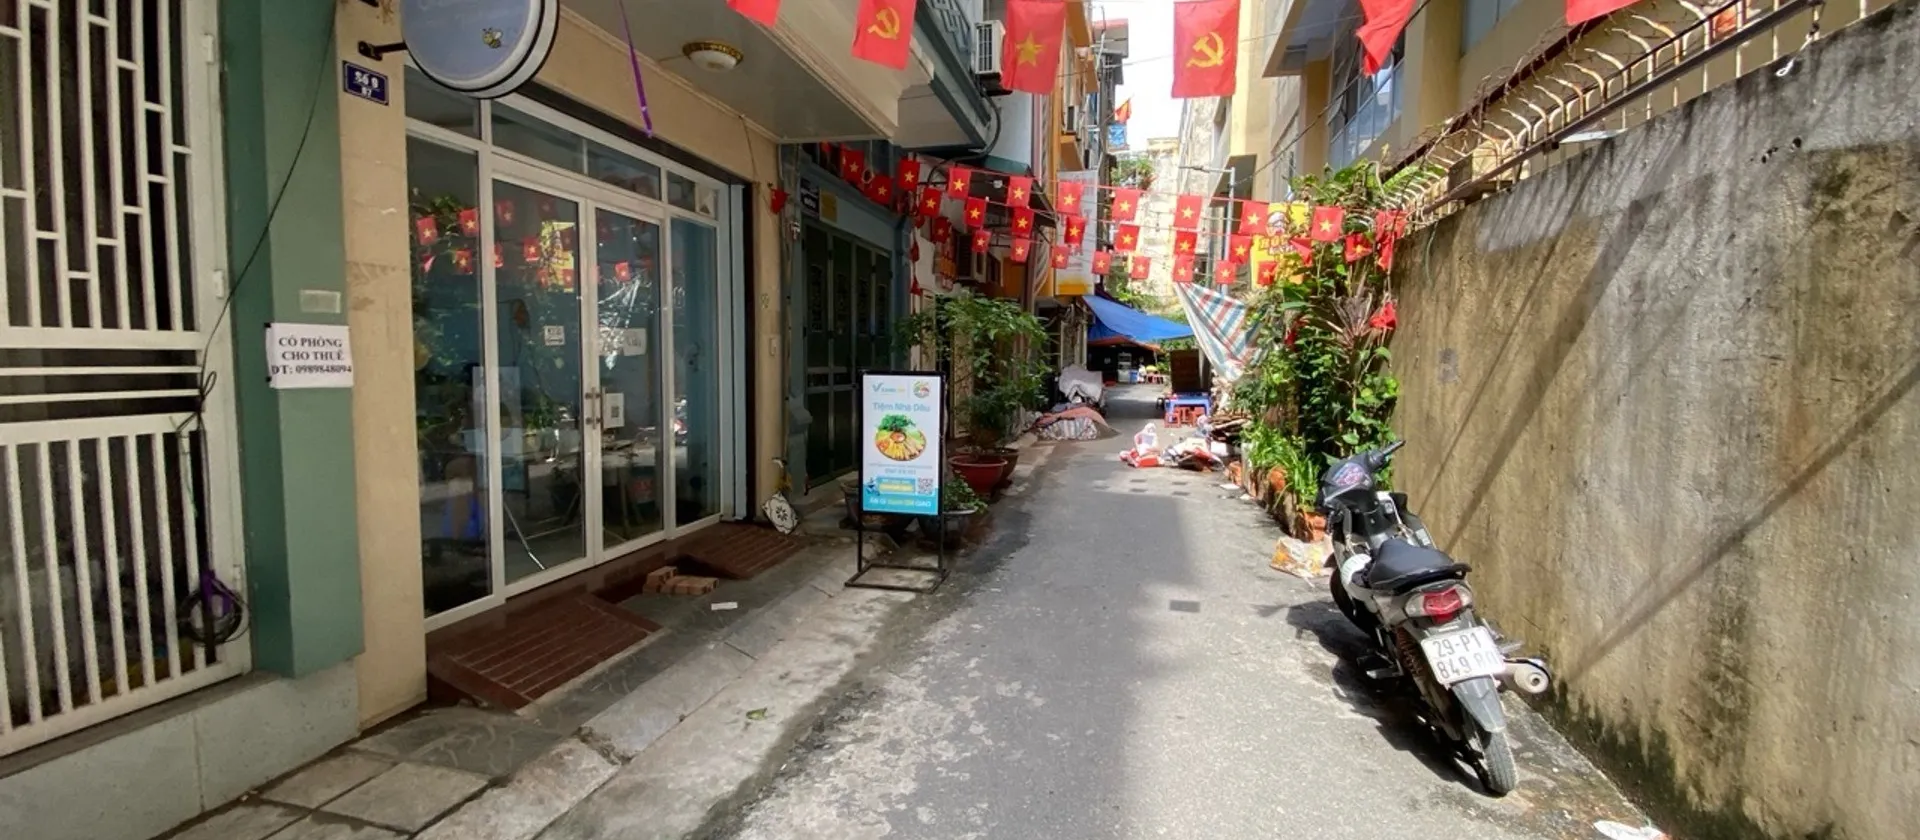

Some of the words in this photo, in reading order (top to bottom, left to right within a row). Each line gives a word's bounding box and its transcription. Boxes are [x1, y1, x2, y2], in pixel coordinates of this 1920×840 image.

[300, 336, 343, 348] PHÒNG
[281, 350, 310, 361] CHO
[313, 349, 344, 361] THUÊ
[1432, 633, 1482, 657] 29-P1
